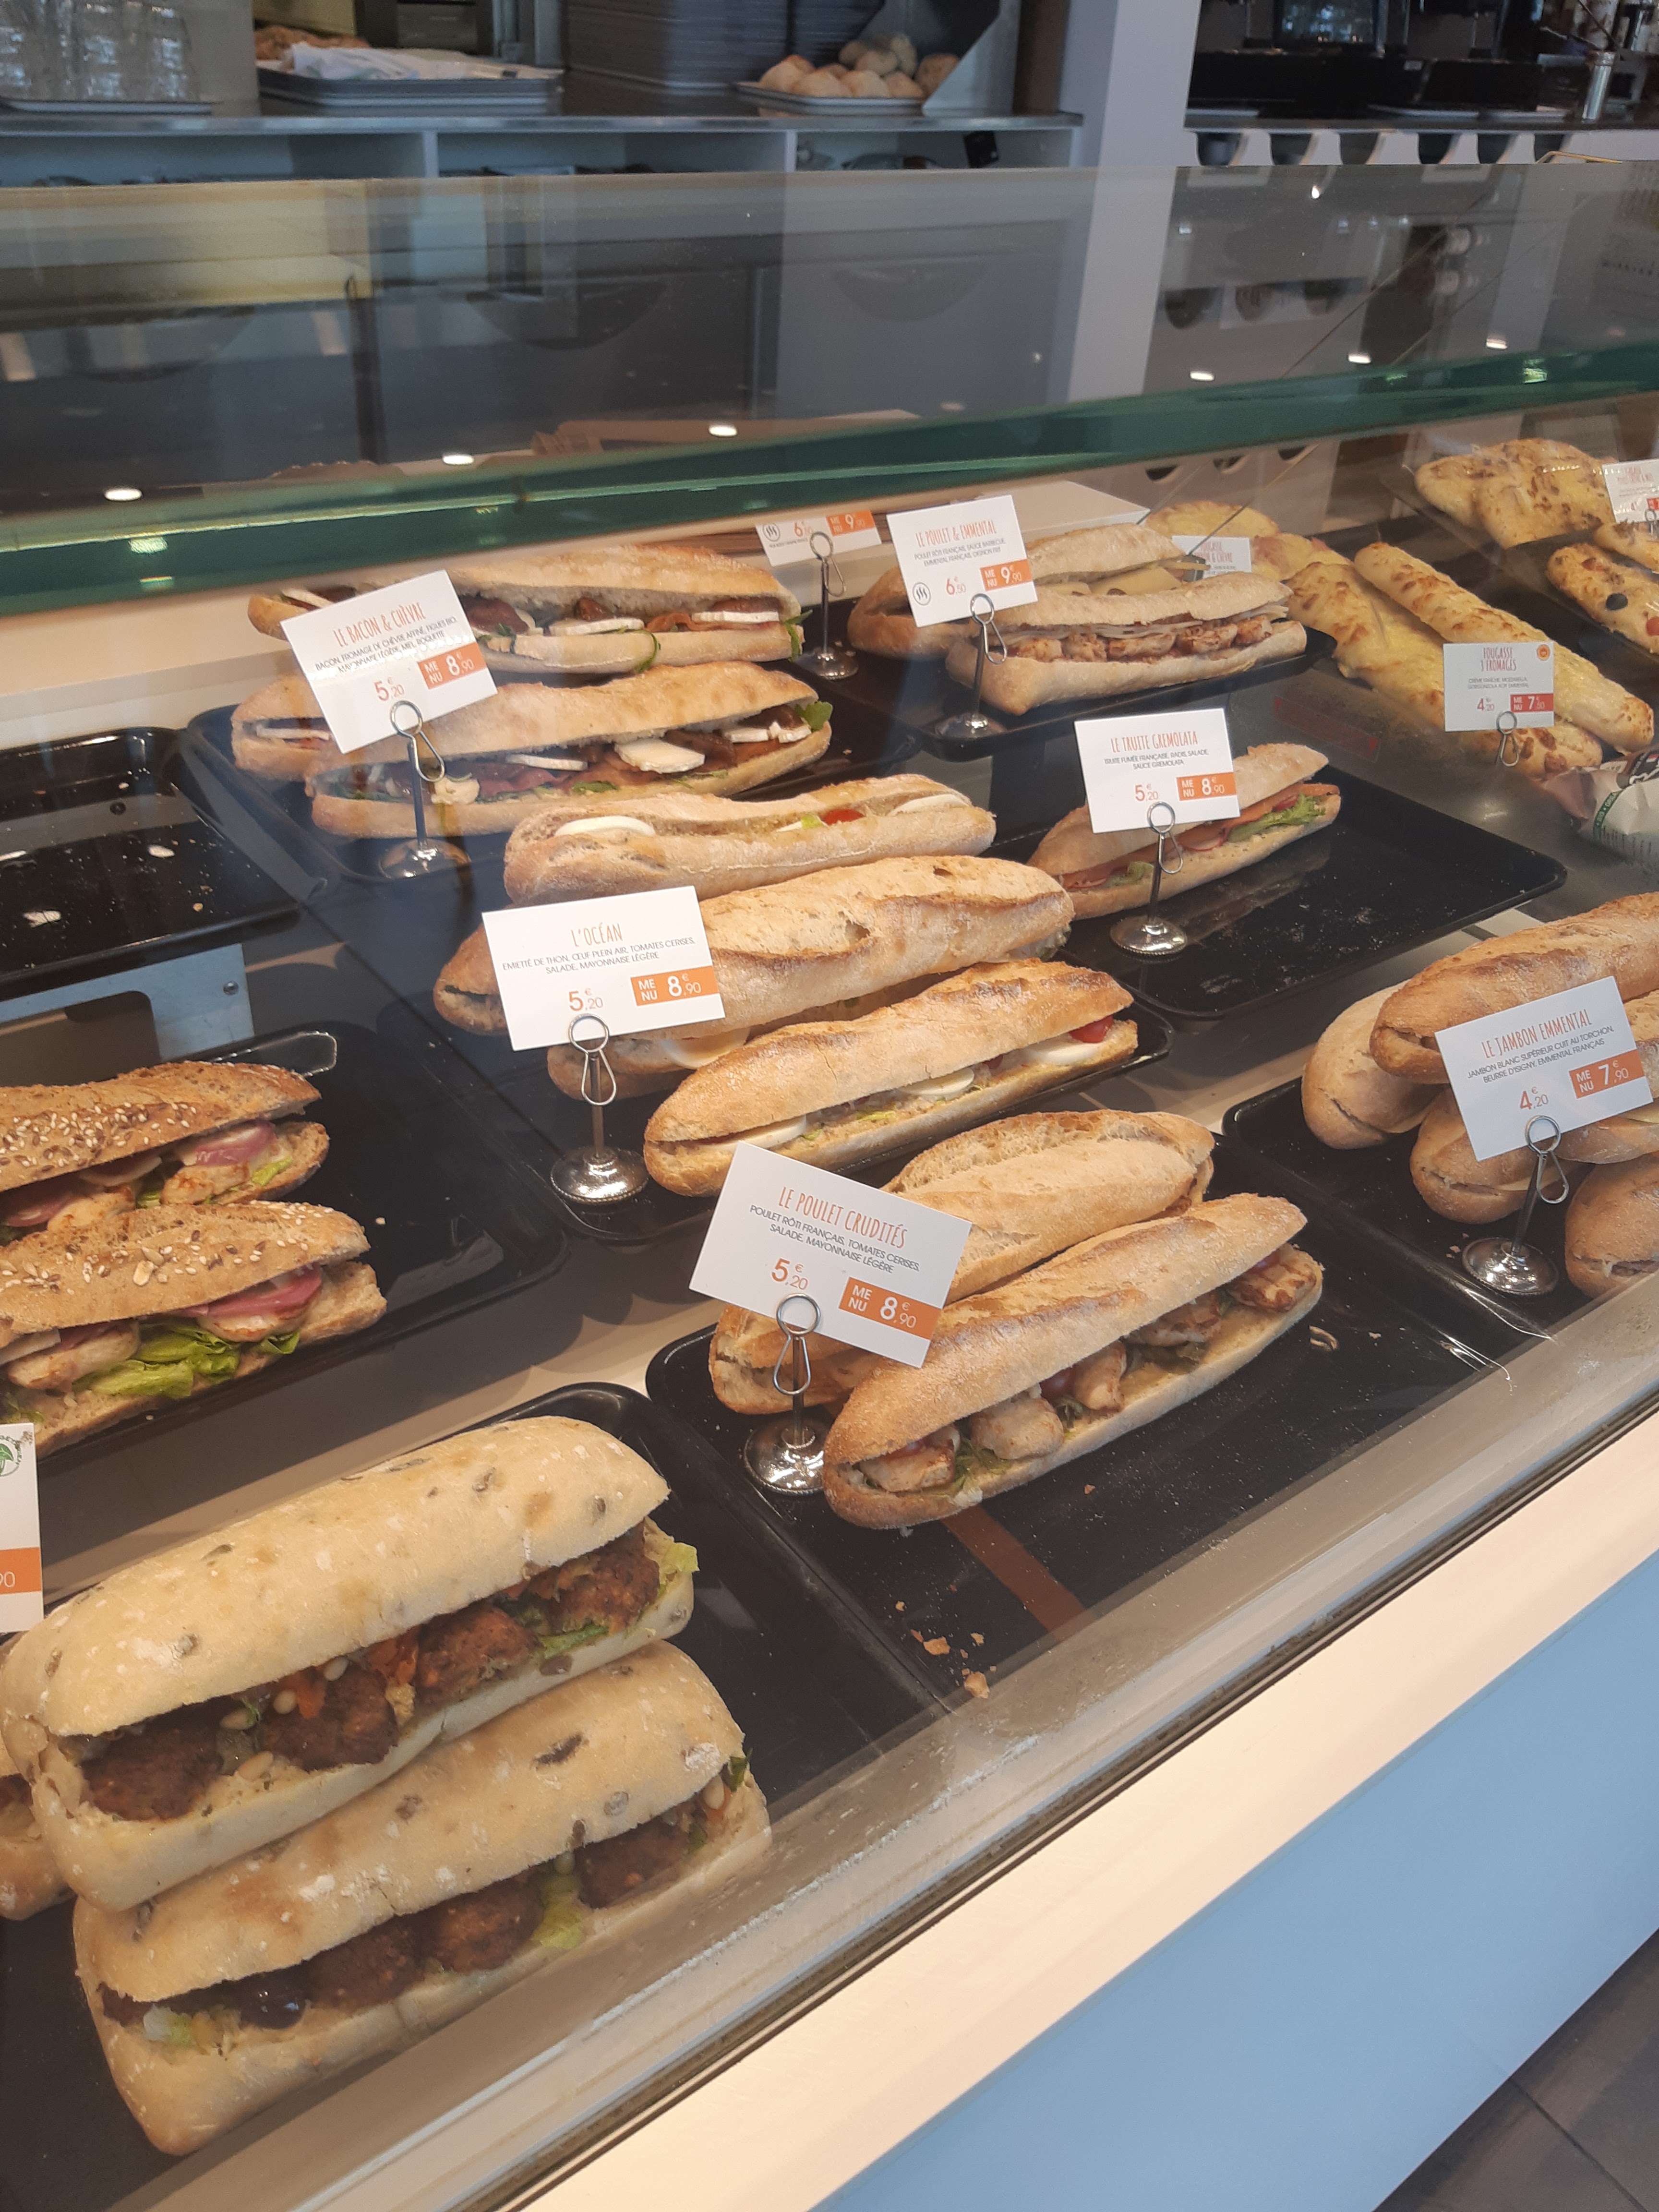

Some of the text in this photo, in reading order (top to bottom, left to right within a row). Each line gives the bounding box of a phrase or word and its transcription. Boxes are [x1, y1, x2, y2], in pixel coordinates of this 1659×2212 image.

[915, 519, 997, 548] LE POULET & EMMENTAL
[984, 569, 996, 578] ME
[987, 578, 998, 588] NU
[333, 602, 427, 648] LE BACON & CHÈVRE
[340, 644, 373, 661] FROMAGE
[1483, 647, 1514, 659] FOUGASSE
[424, 661, 440, 673] ME
[1486, 660, 1516, 672] FROMAGES
[429, 672, 443, 684] NU
[1111, 731, 1198, 753] LE TRUITE GREMOLATA
[1152, 759, 1184, 768] GREMOLATA
[1181, 780, 1193, 788] ME
[1183, 788, 1195, 798] NU
[571, 922, 623, 947] L'OCÉAN
[534, 958, 545, 966] DE
[592, 949, 613, 959] PLEIN
[630, 941, 664, 953] TOMATES
[579, 956, 630, 969] MAYONNAISE
[631, 951, 660, 962] LÉGÈRE
[638, 979, 656, 990] ME
[641, 990, 658, 1002] NU
[1481, 1009, 1592, 1058] LE JAMBON EMMENTAL
[1467, 1063, 1497, 1079] JAMBON
[1497, 1056, 1520, 1069] BLANC
[1520, 1044, 1553, 1061] SUPÉRIEUR
[1554, 1039, 1569, 1050] CUIT
[1570, 1037, 1580, 1046] AU
[1483, 1070, 1508, 1083] BEURRE
[1538, 1049, 1572, 1066] EMMENTAL
[1572, 1038, 1605, 1054] FRANÇAIS
[1576, 1070, 1591, 1082] ME
[1579, 1082, 1594, 1093] NU
[778, 1186, 908, 1250] LE POULET CRUDITÉS
[749, 1204, 782, 1223] POULET
[782, 1216, 803, 1230] RÔTI
[848, 1238, 886, 1260] TOMATES
[805, 1236, 863, 1263] MAYONNAISE
[863, 1255, 895, 1274] LÉGÈRE
[852, 1285, 873, 1301] ME
[848, 1298, 868, 1313] NU
